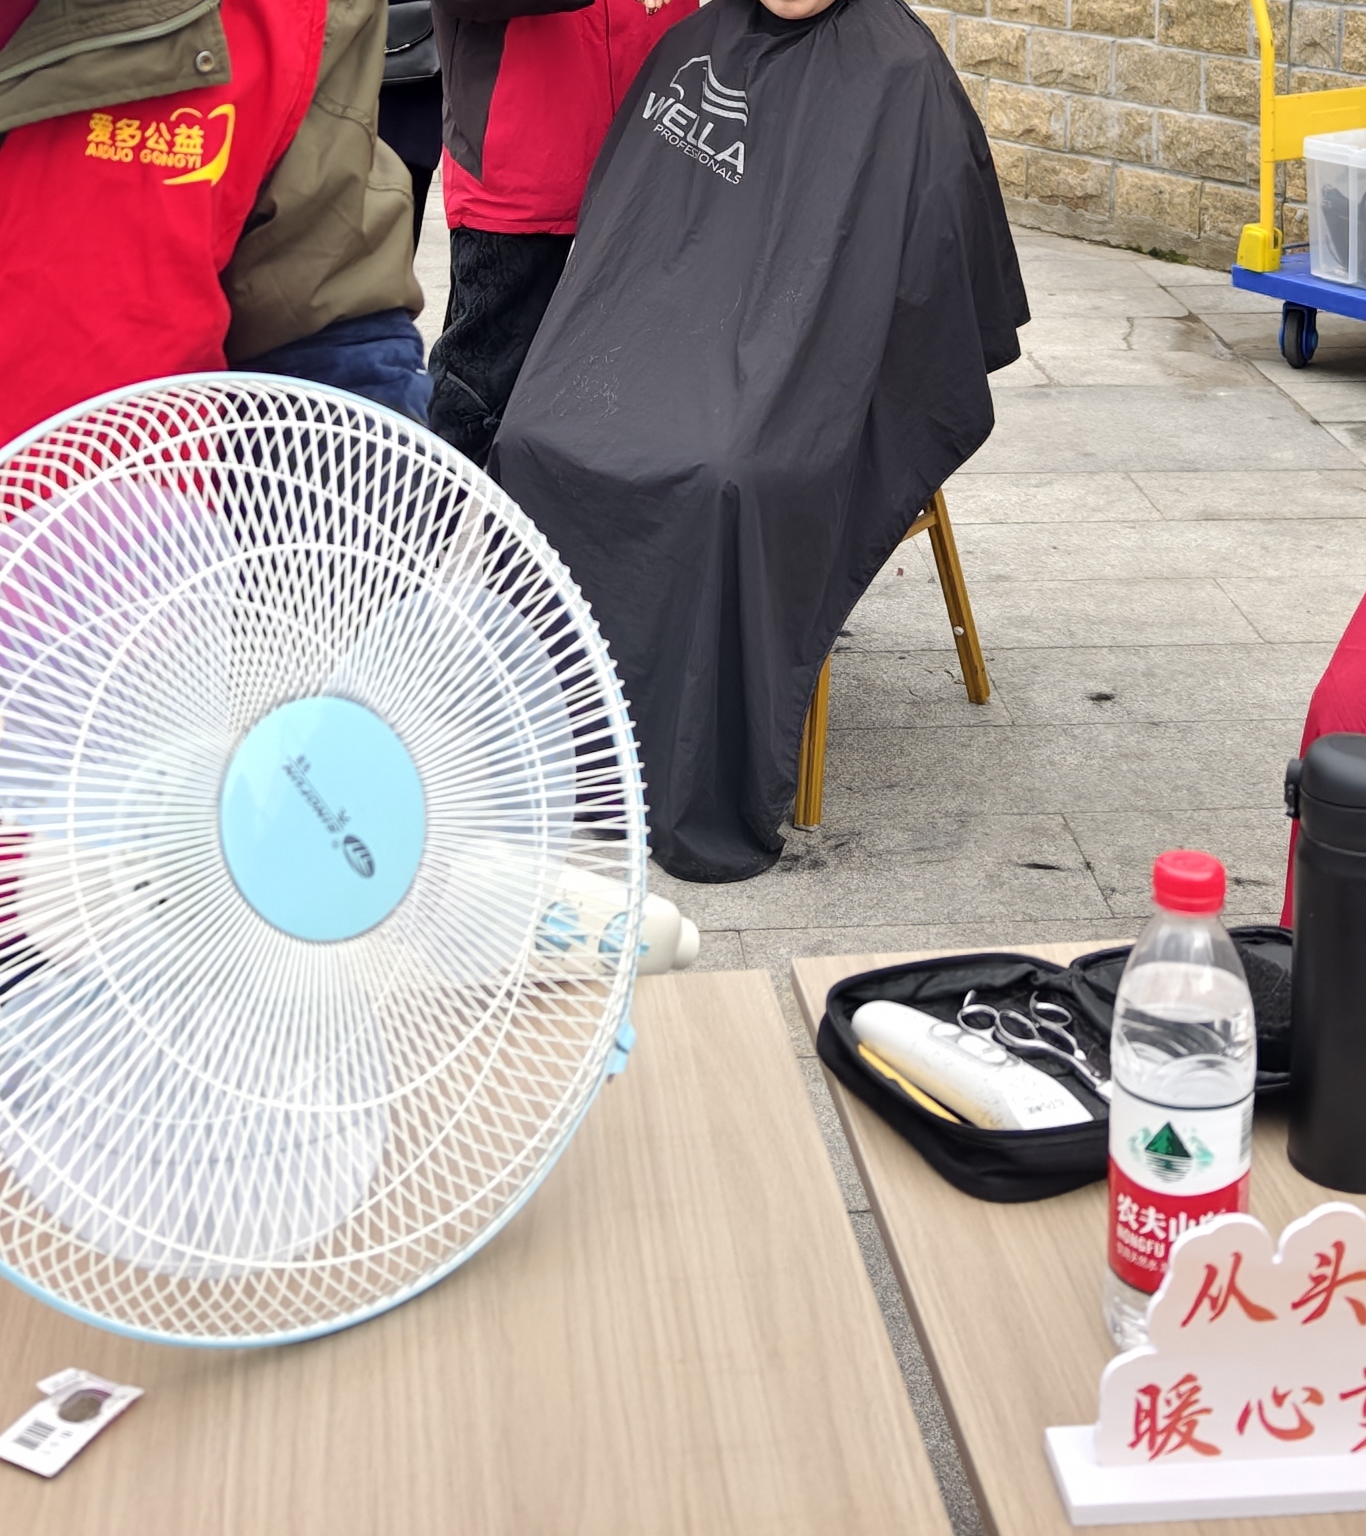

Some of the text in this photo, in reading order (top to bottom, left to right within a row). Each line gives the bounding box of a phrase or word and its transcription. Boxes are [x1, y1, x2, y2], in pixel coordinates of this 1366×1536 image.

[84, 142, 202, 169] AIDUO GONGYI
[86, 112, 205, 155] 爱多公益
[641, 91, 746, 175] WELLA
[1116, 1192, 1227, 1243] 农夫山
